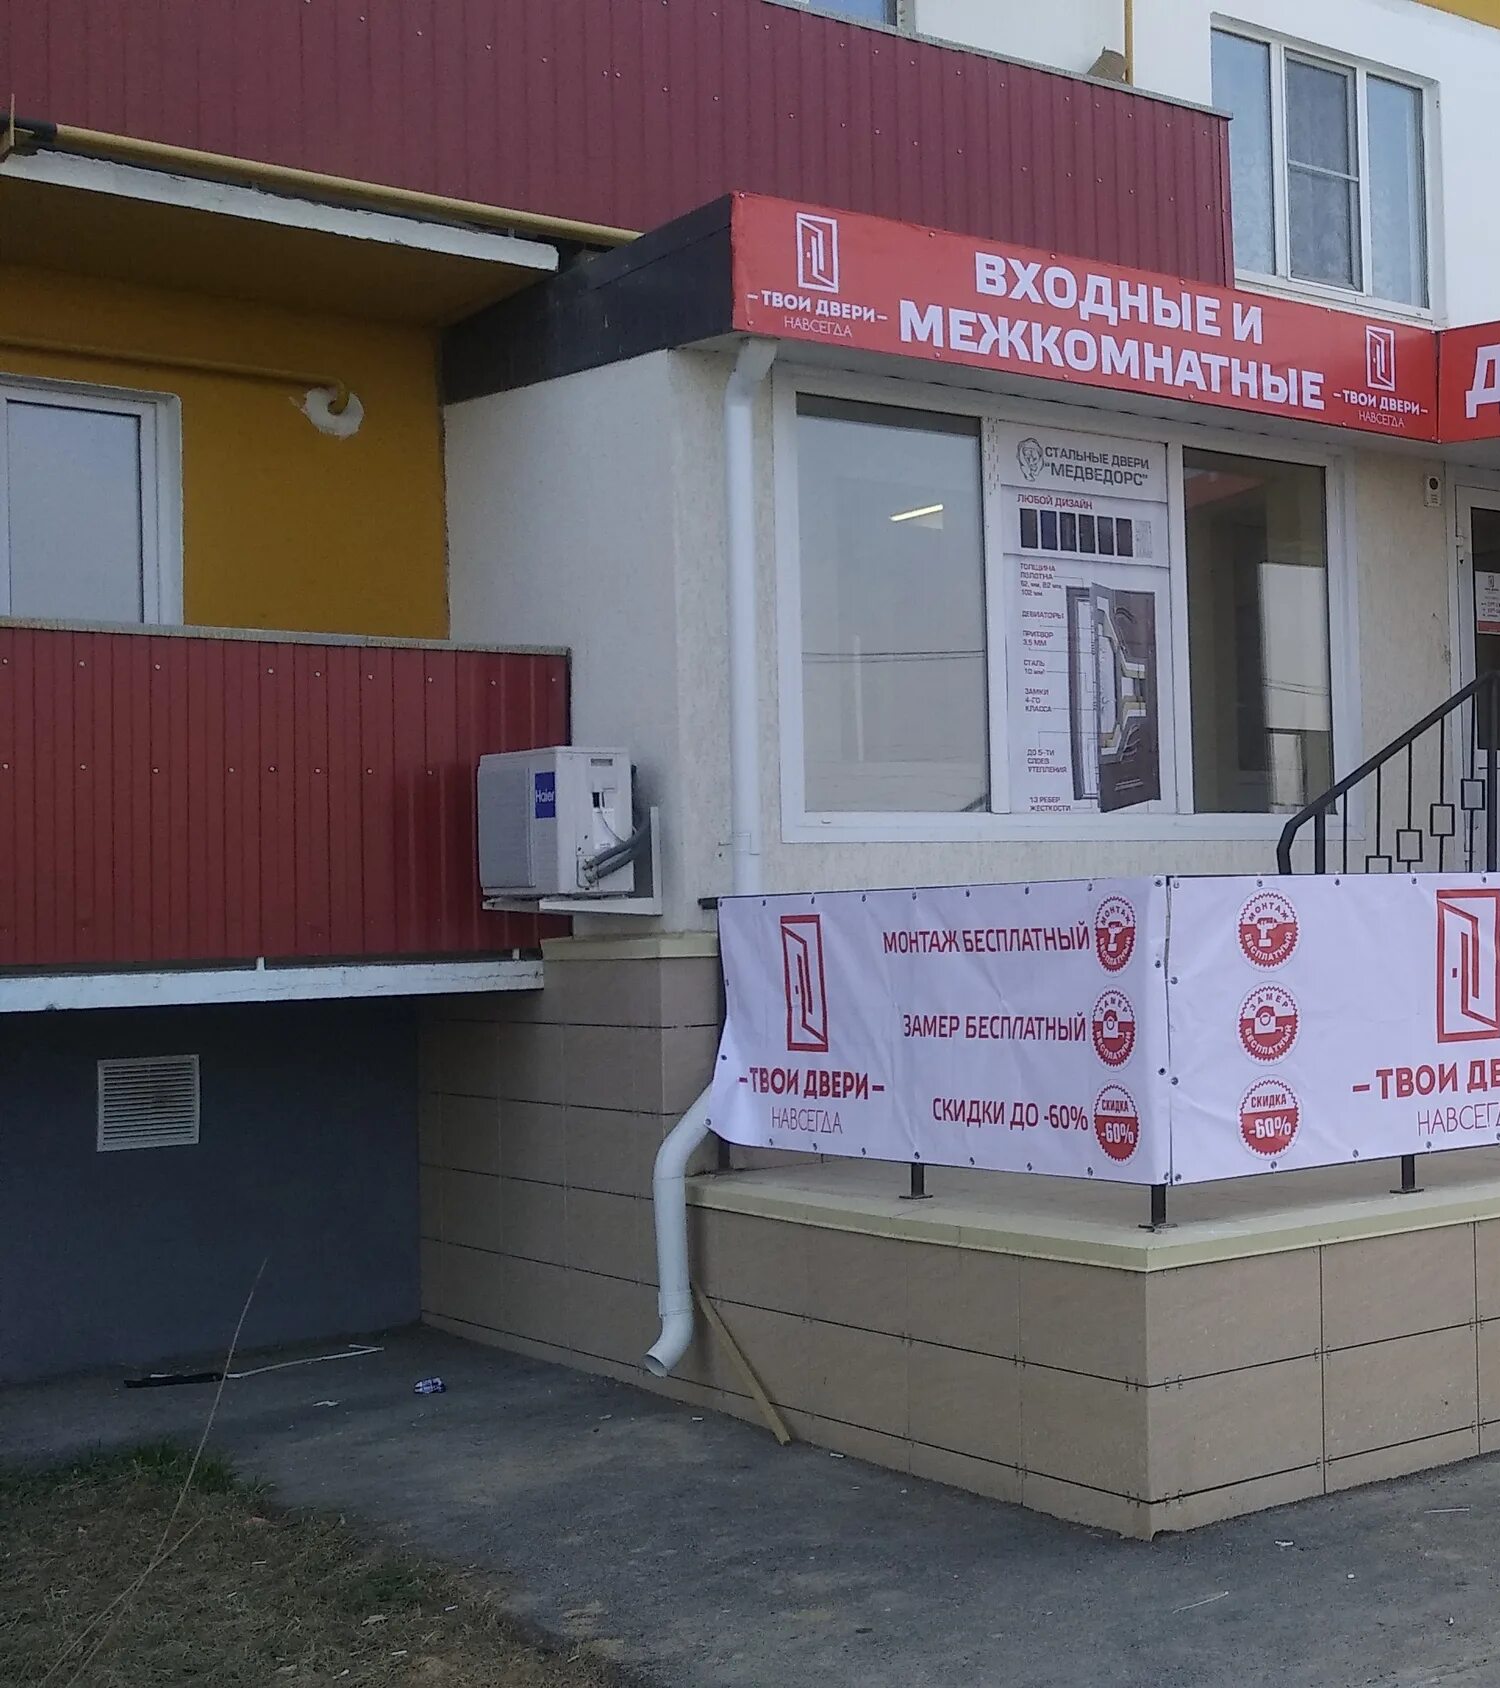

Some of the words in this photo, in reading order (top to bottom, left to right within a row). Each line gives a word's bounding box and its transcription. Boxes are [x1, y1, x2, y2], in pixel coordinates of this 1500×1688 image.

[974, 251, 1222, 335] ВХОДНЫЕ
[1233, 304, 1263, 344] И
[784, 316, 853, 338] НАВСЕГДА
[899, 300, 1326, 410] МЕЖКОМНАТНЫЕ
[1359, 410, 1405, 428] НАВСЕГДА
[1045, 446, 1109, 464] СТАЛЬНЫЕ
[1111, 454, 1150, 470] ДВЕРИ
[1017, 493, 1053, 506] ЛЮБОЙ
[1055, 497, 1093, 510] ДИЗАЙН
[536, 788, 554, 803] Haier
[1101, 906, 1131, 926] МОНТАЖ
[1249, 902, 1289, 922] МОНТАЖ
[883, 931, 960, 955] МОНТАЖ
[964, 922, 1091, 954] БЕСПЛАТНЫЙ
[1250, 993, 1289, 1012] ЗАМЕР
[903, 1014, 960, 1039] ЗАМЕР
[965, 1012, 1086, 1042] БЕСПЛАТНЫЙ
[1101, 1099, 1129, 1113] СКИДКА
[1251, 1094, 1286, 1108] СКИДКА
[771, 1106, 843, 1135] НАВСЕГДА
[932, 1098, 1005, 1126] СКИДКИ
[1010, 1104, 1039, 1131] ДО
[1043, 1105, 1089, 1131] -60%
[1101, 1122, 1134, 1144] -60%
[1249, 1116, 1291, 1139] -60%
